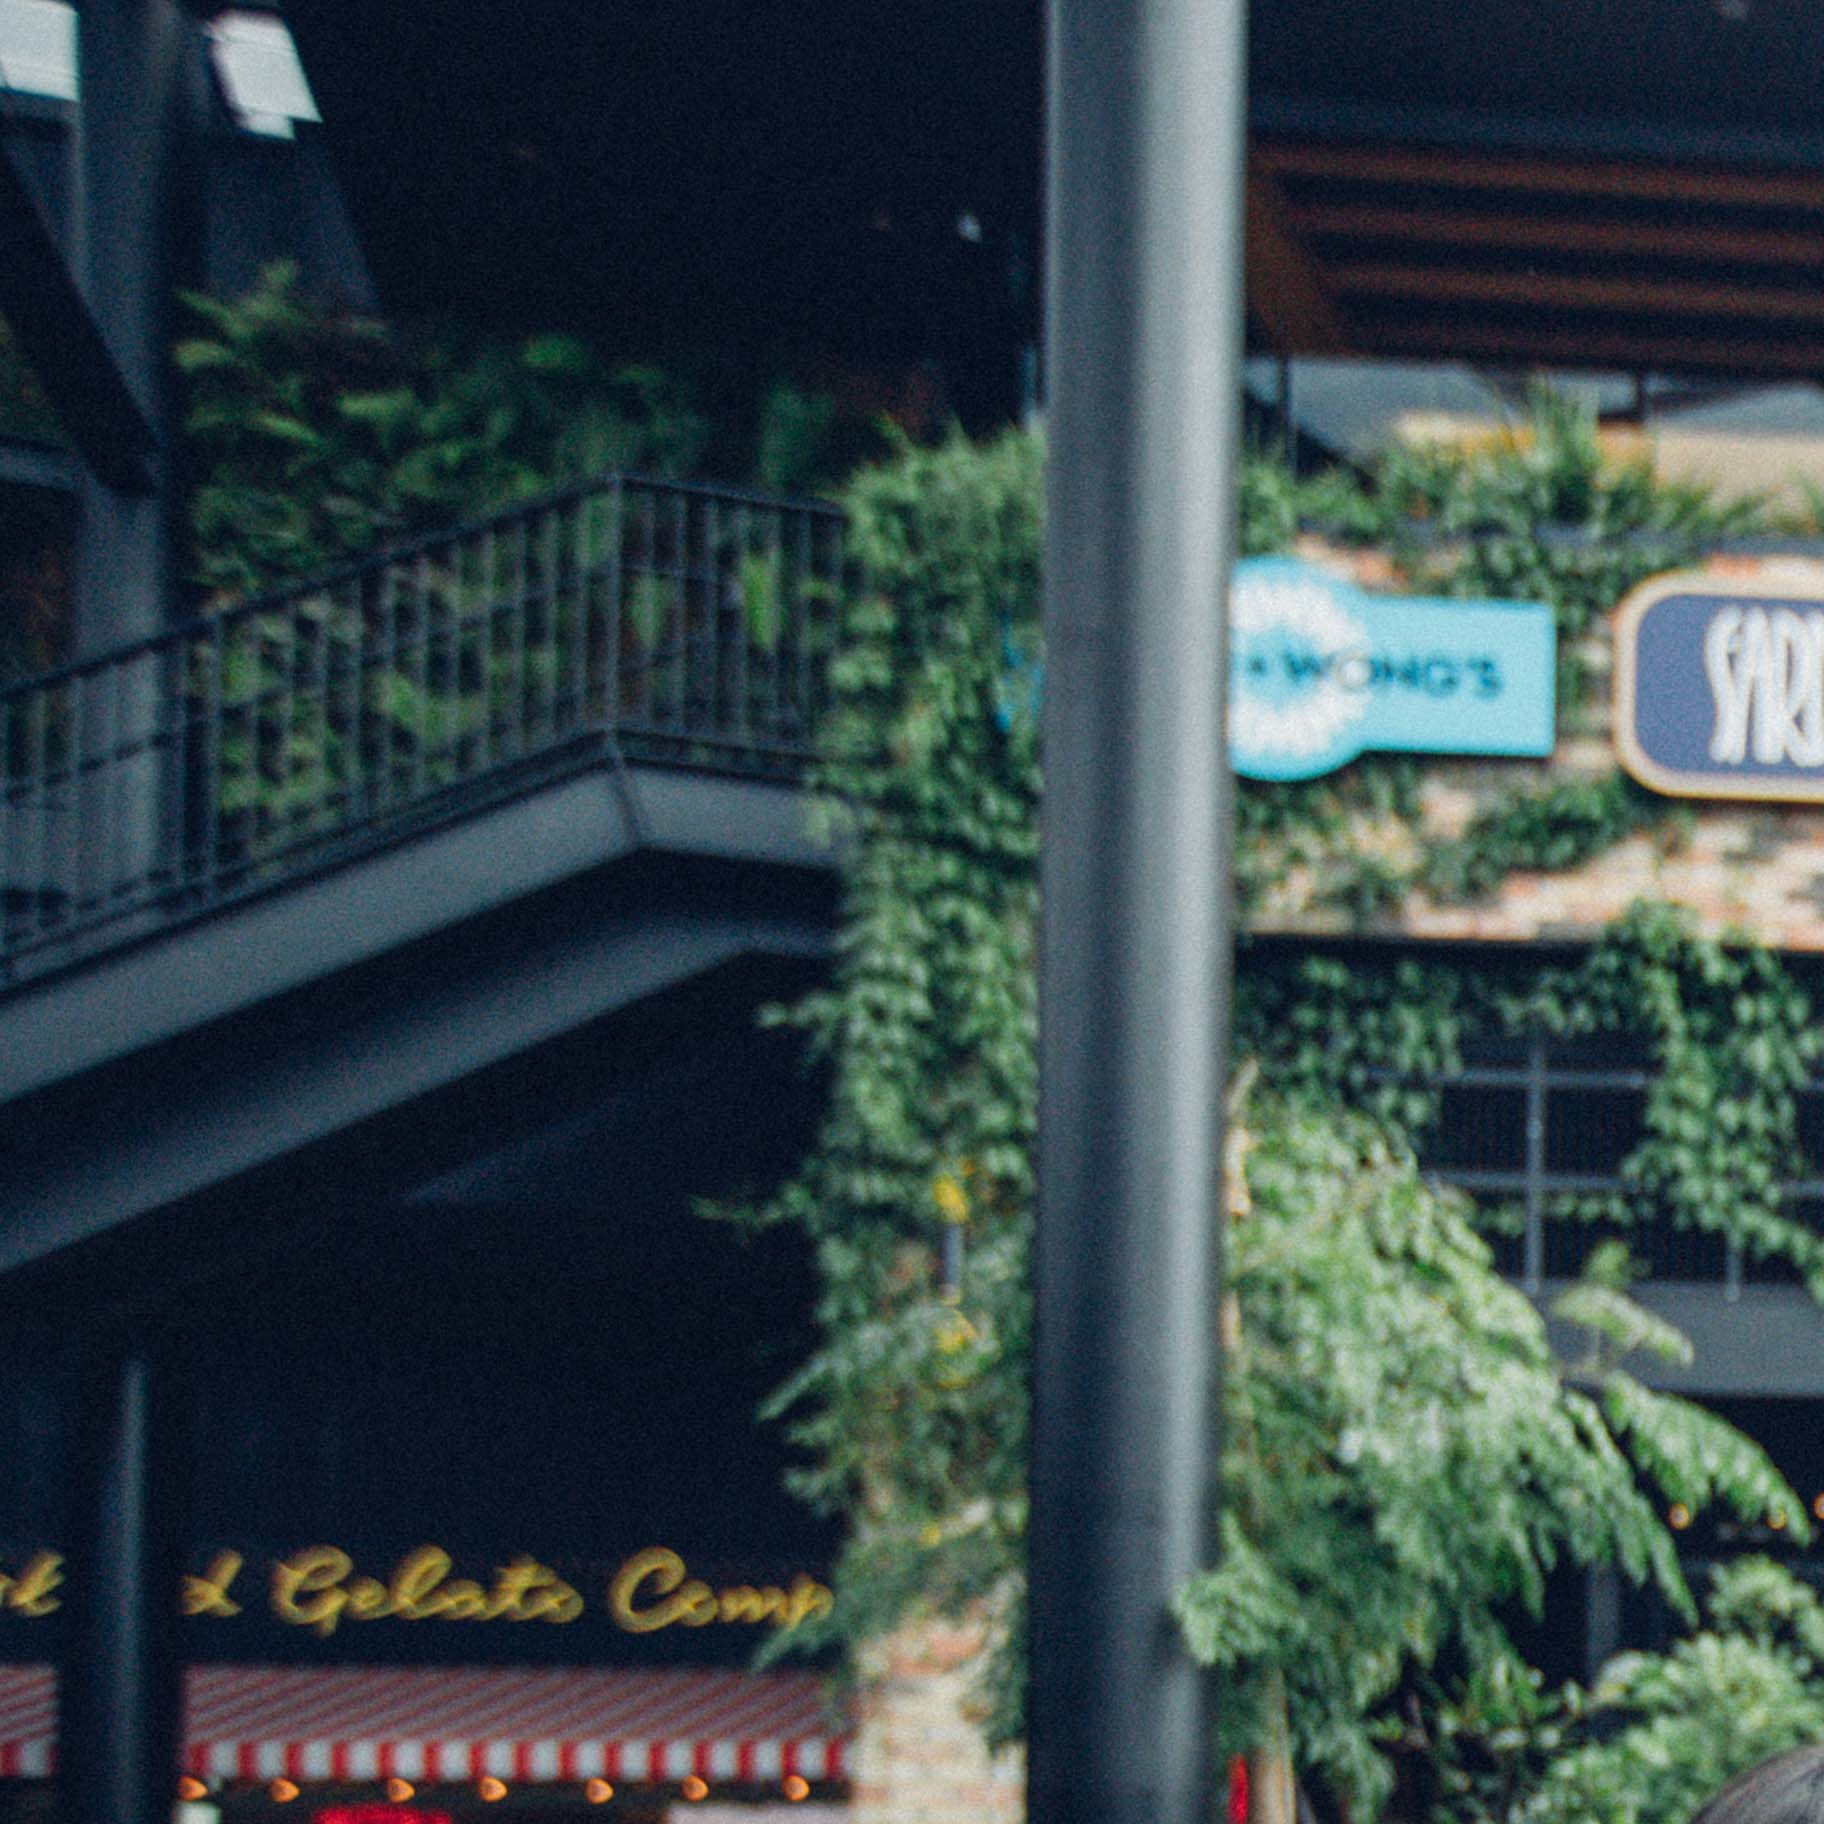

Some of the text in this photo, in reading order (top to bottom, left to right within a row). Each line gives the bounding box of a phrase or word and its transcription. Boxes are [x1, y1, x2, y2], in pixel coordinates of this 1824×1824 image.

[1282, 648, 1503, 698] WONG'S
[272, 1545, 585, 1636] Gelato
[608, 1546, 836, 1633] Comp
